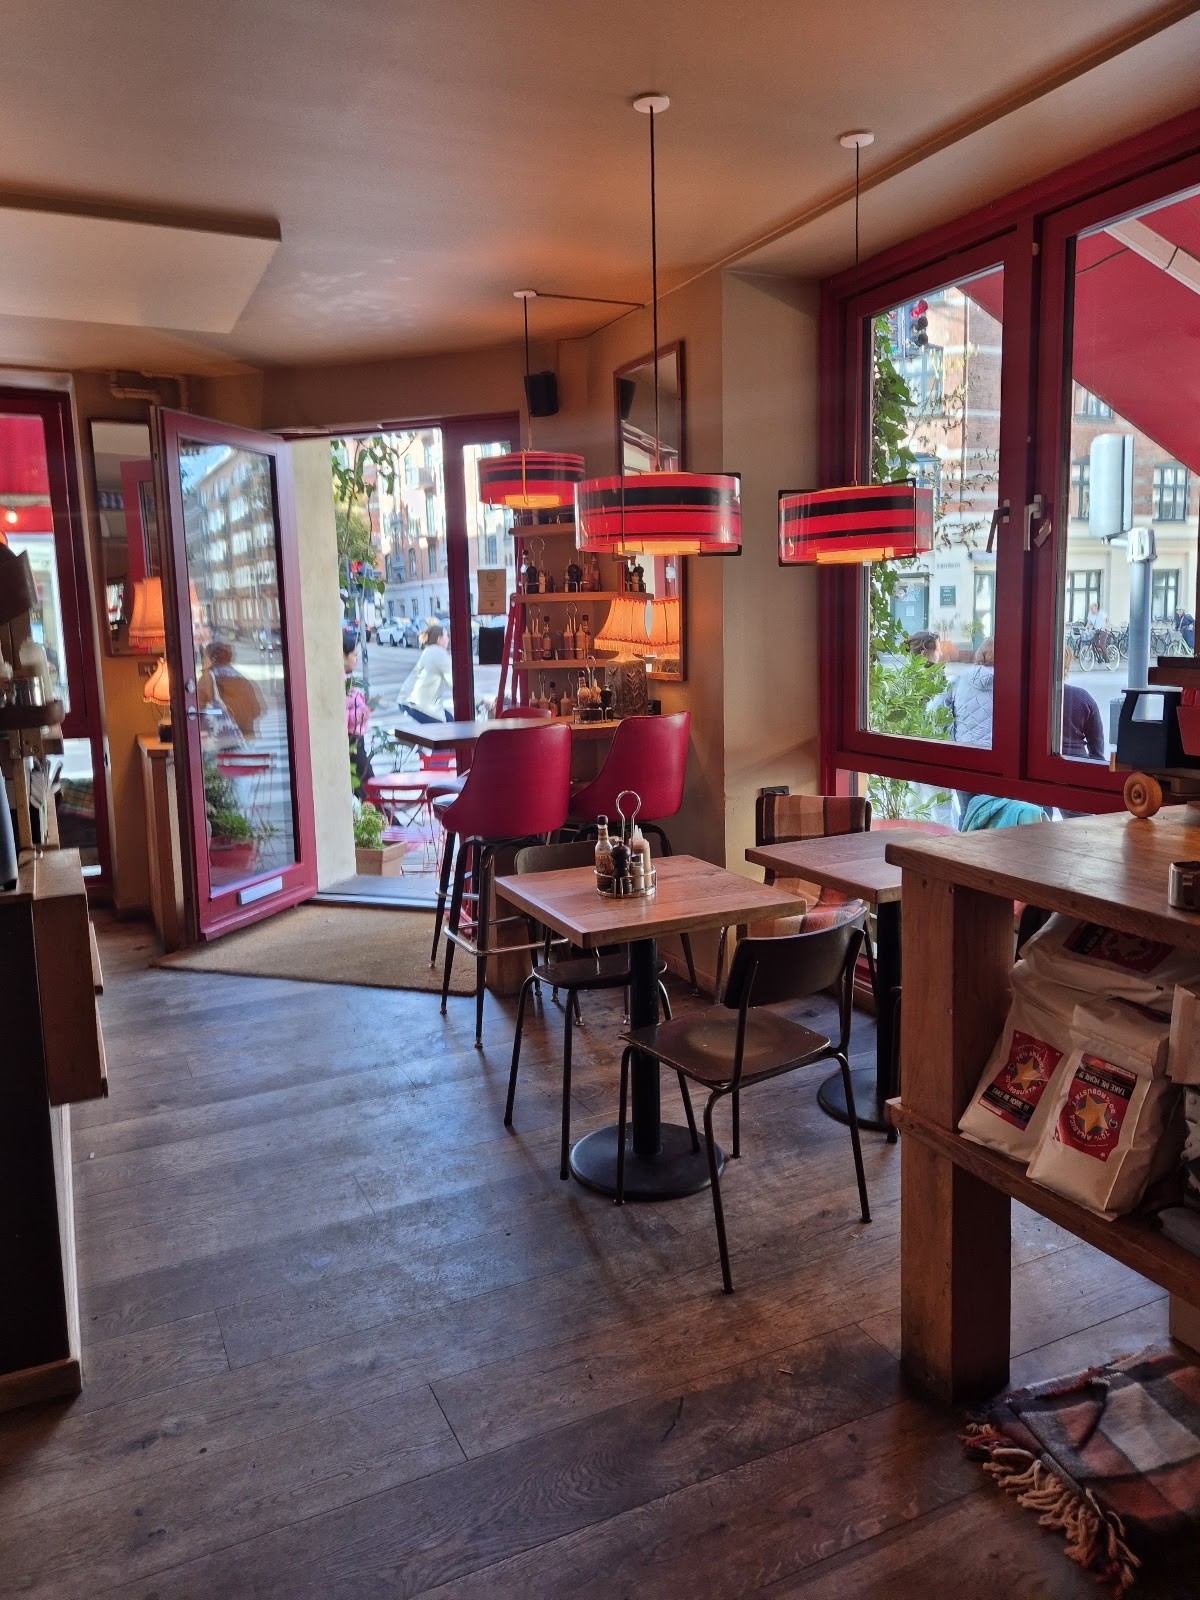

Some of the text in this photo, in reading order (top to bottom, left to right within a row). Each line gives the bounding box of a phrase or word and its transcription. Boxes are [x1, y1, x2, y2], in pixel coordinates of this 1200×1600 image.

[1085, 1073, 1100, 1084] HOME
[1100, 1081, 1110, 1090] ME
[1111, 1085, 1126, 1096] TAKE
[992, 1087, 1004, 1098] TAKE
[1009, 1095, 1024, 1108] HOME
[1075, 1088, 1107, 1100] ROBUSTA
[1070, 1114, 1110, 1141] 70% ARABICA
